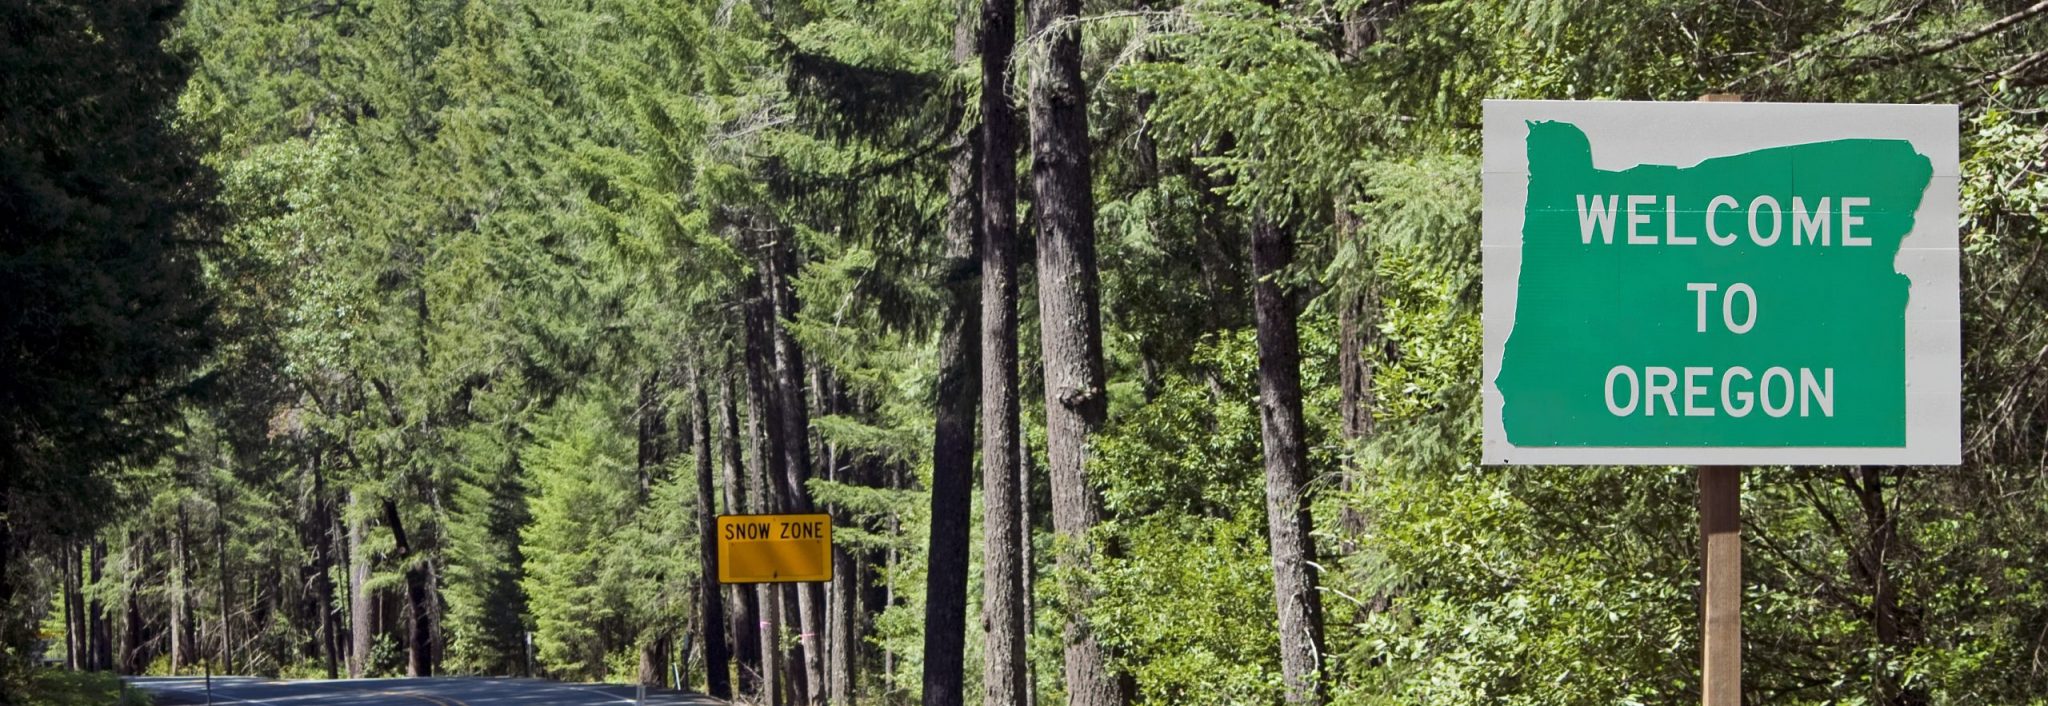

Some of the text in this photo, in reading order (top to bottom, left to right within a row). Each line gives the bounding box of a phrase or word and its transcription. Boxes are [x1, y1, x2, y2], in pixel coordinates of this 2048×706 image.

[1576, 194, 1872, 247] WELCOME
[1687, 282, 1758, 335] TO
[1604, 365, 1834, 418] OREGON
[725, 522, 823, 540] SNOW ZONE
